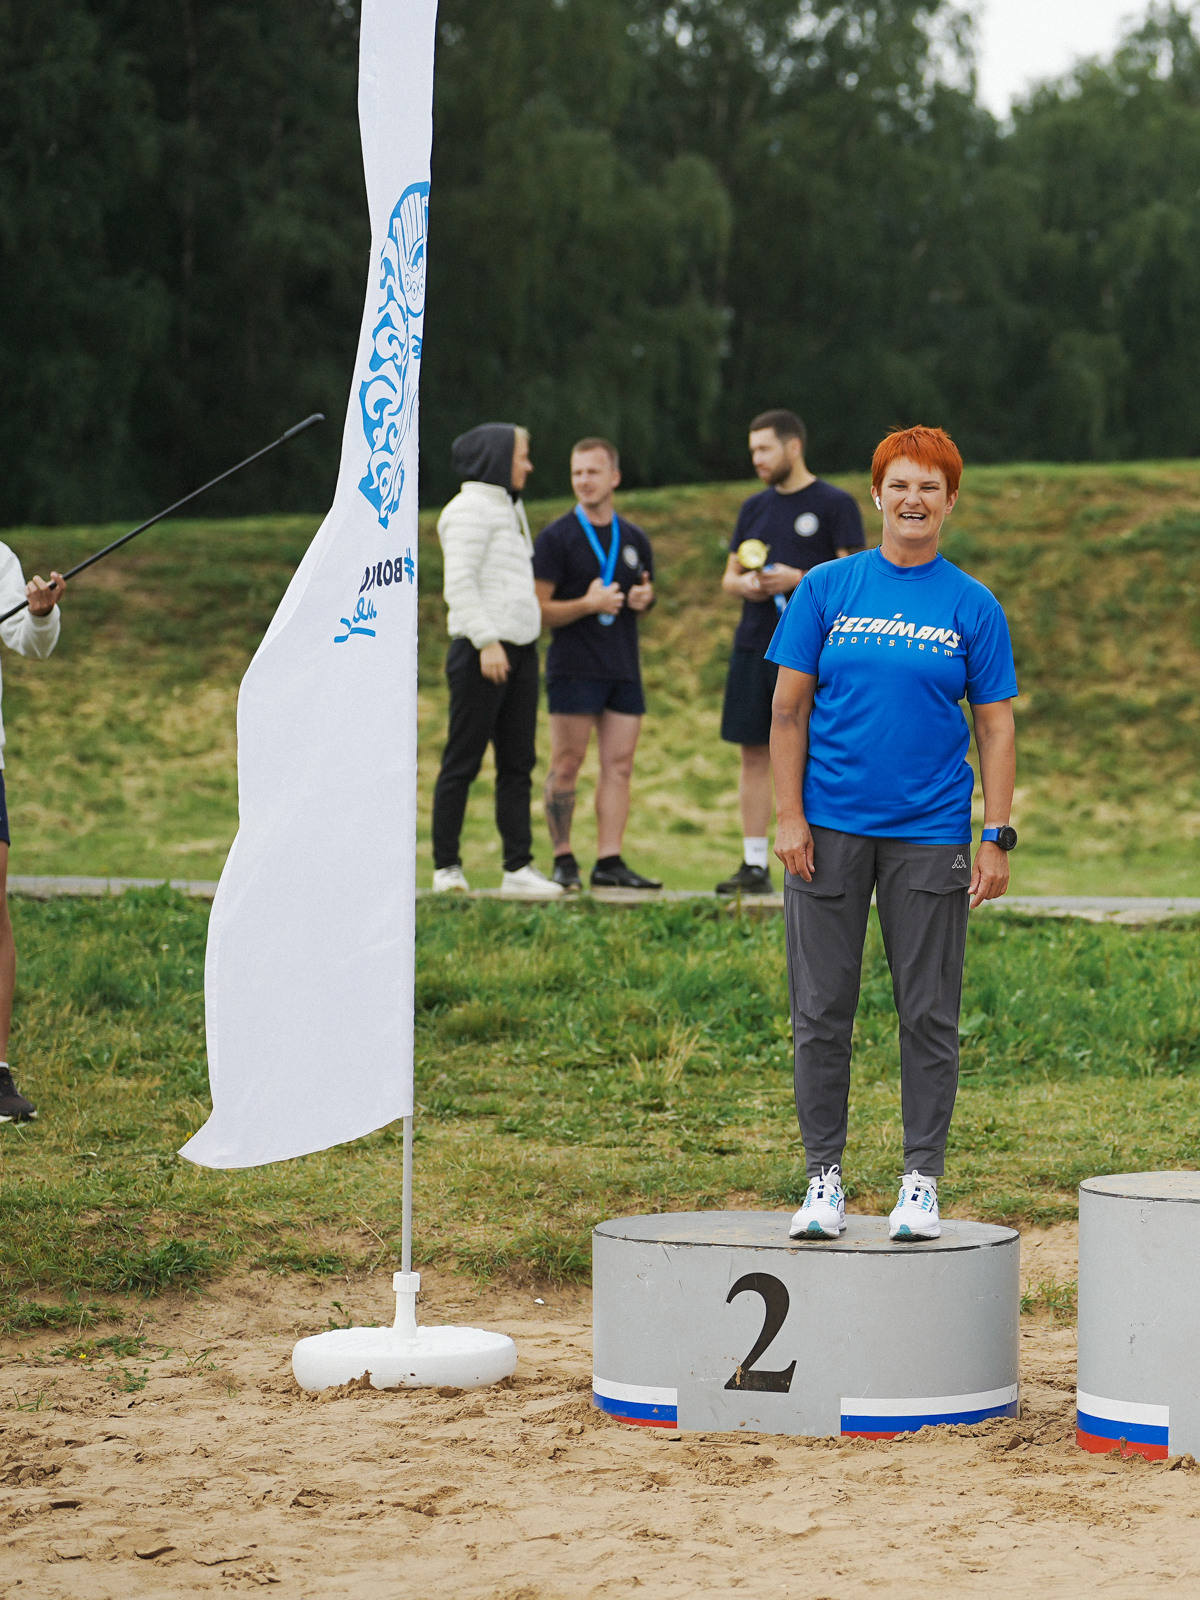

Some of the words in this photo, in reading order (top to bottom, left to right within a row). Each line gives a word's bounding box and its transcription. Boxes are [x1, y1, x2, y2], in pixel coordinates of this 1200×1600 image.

[828, 634, 896, 647] Sports
[906, 639, 954, 657] Team
[723, 1271, 798, 1394] 2
